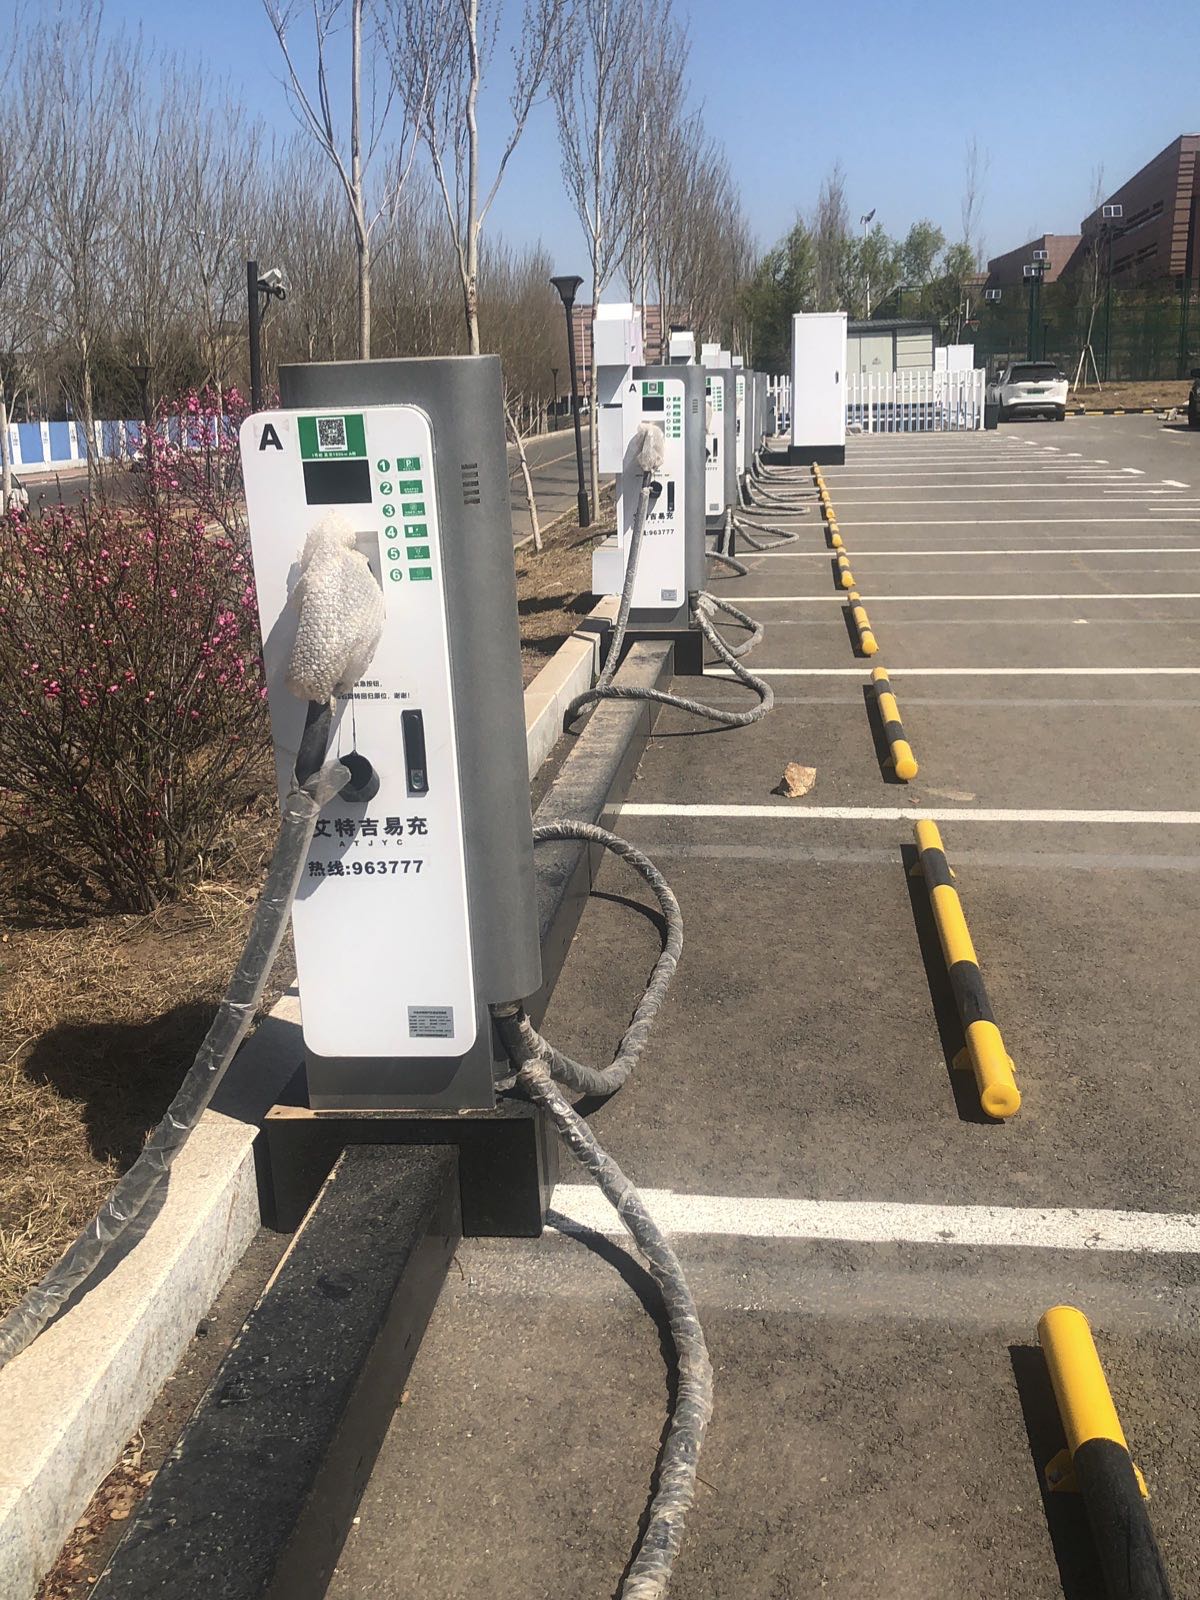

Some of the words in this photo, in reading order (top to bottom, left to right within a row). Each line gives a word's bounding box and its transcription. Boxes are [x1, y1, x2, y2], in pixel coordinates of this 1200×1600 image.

[628, 383, 637, 392] A
[258, 423, 284, 451] A
[382, 482, 391, 494] 2
[385, 505, 394, 516] 3
[386, 526, 396, 538] 4
[390, 548, 399, 559] 5
[392, 570, 401, 581] 6
[313, 816, 429, 838] 艾特吉易充
[339, 839, 403, 848] ATJYC
[308, 860, 424, 877] 热线:963777
